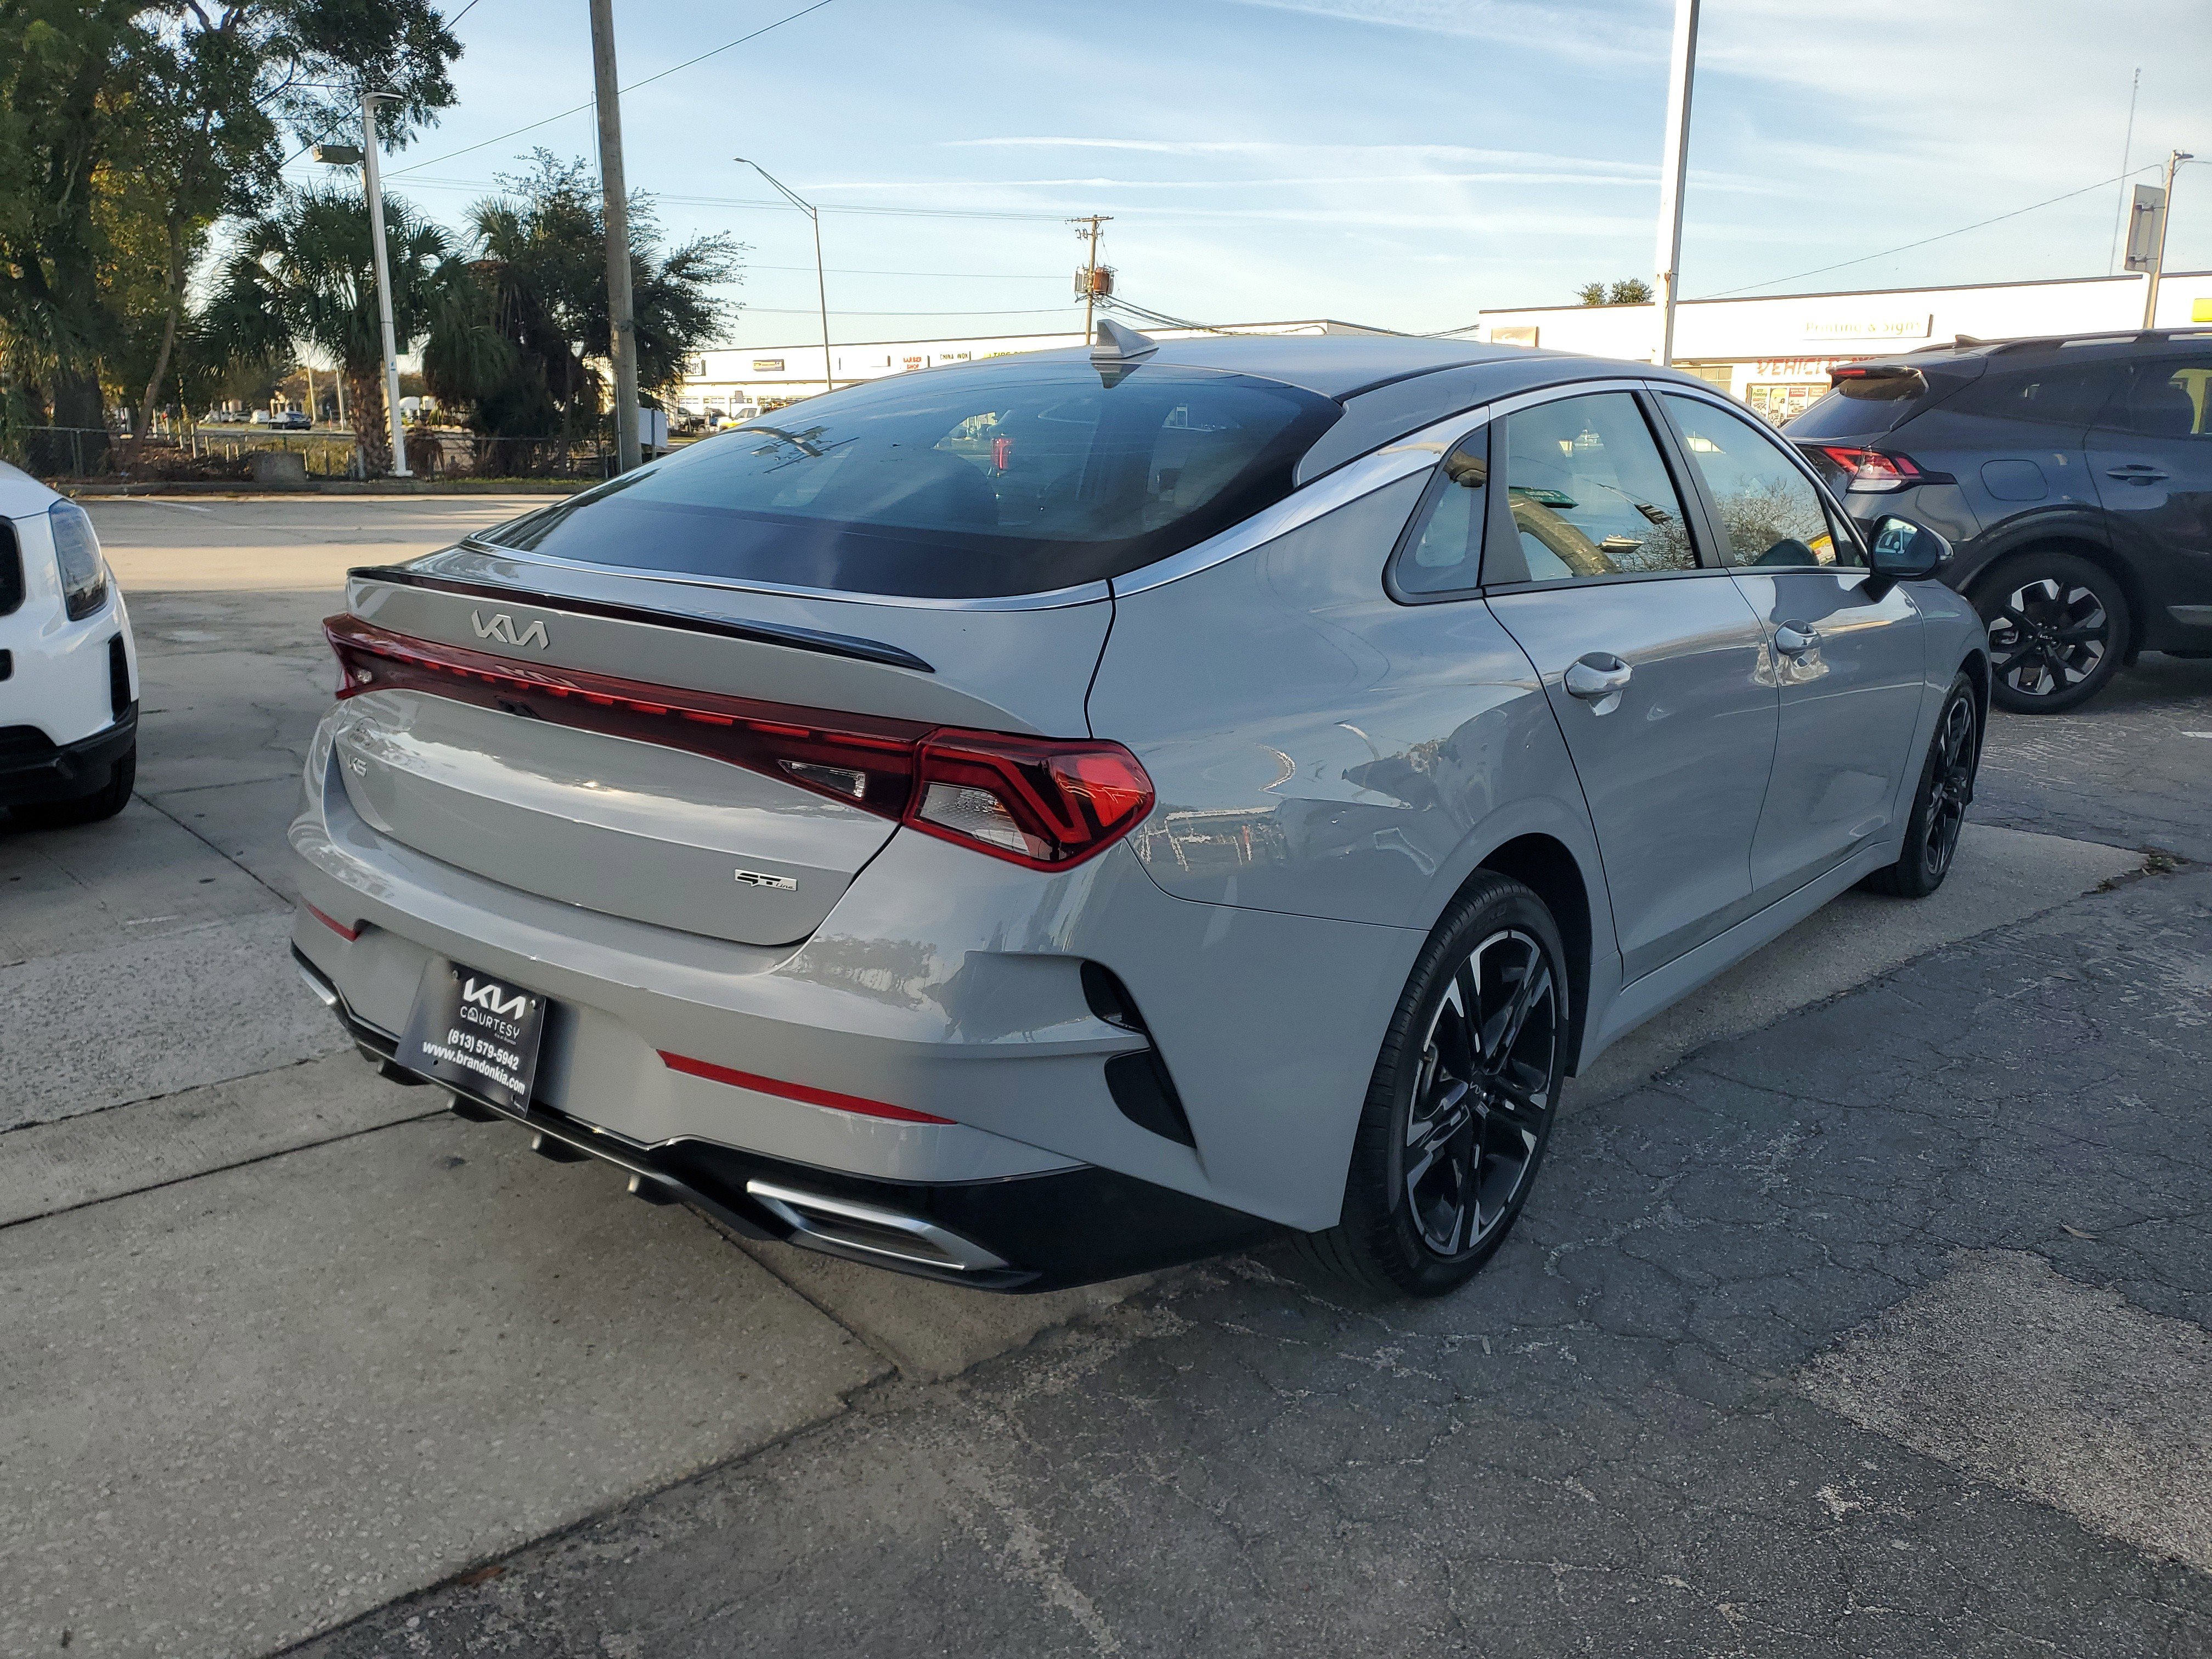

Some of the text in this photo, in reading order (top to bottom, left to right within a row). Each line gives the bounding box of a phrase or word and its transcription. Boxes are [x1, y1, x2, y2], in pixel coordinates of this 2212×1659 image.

[1805, 321, 1862, 334] Printing
[1867, 323, 1877, 332] &
[471, 610, 550, 650] KIA
[348, 754, 367, 778] K5
[463, 977, 526, 1020] KIA
[460, 1006, 520, 1040] COURTESY
[422, 1041, 526, 1096] www.brandonkia.com
[448, 1029, 475, 1053] (813)
[476, 1039, 520, 1070] 579-5942
